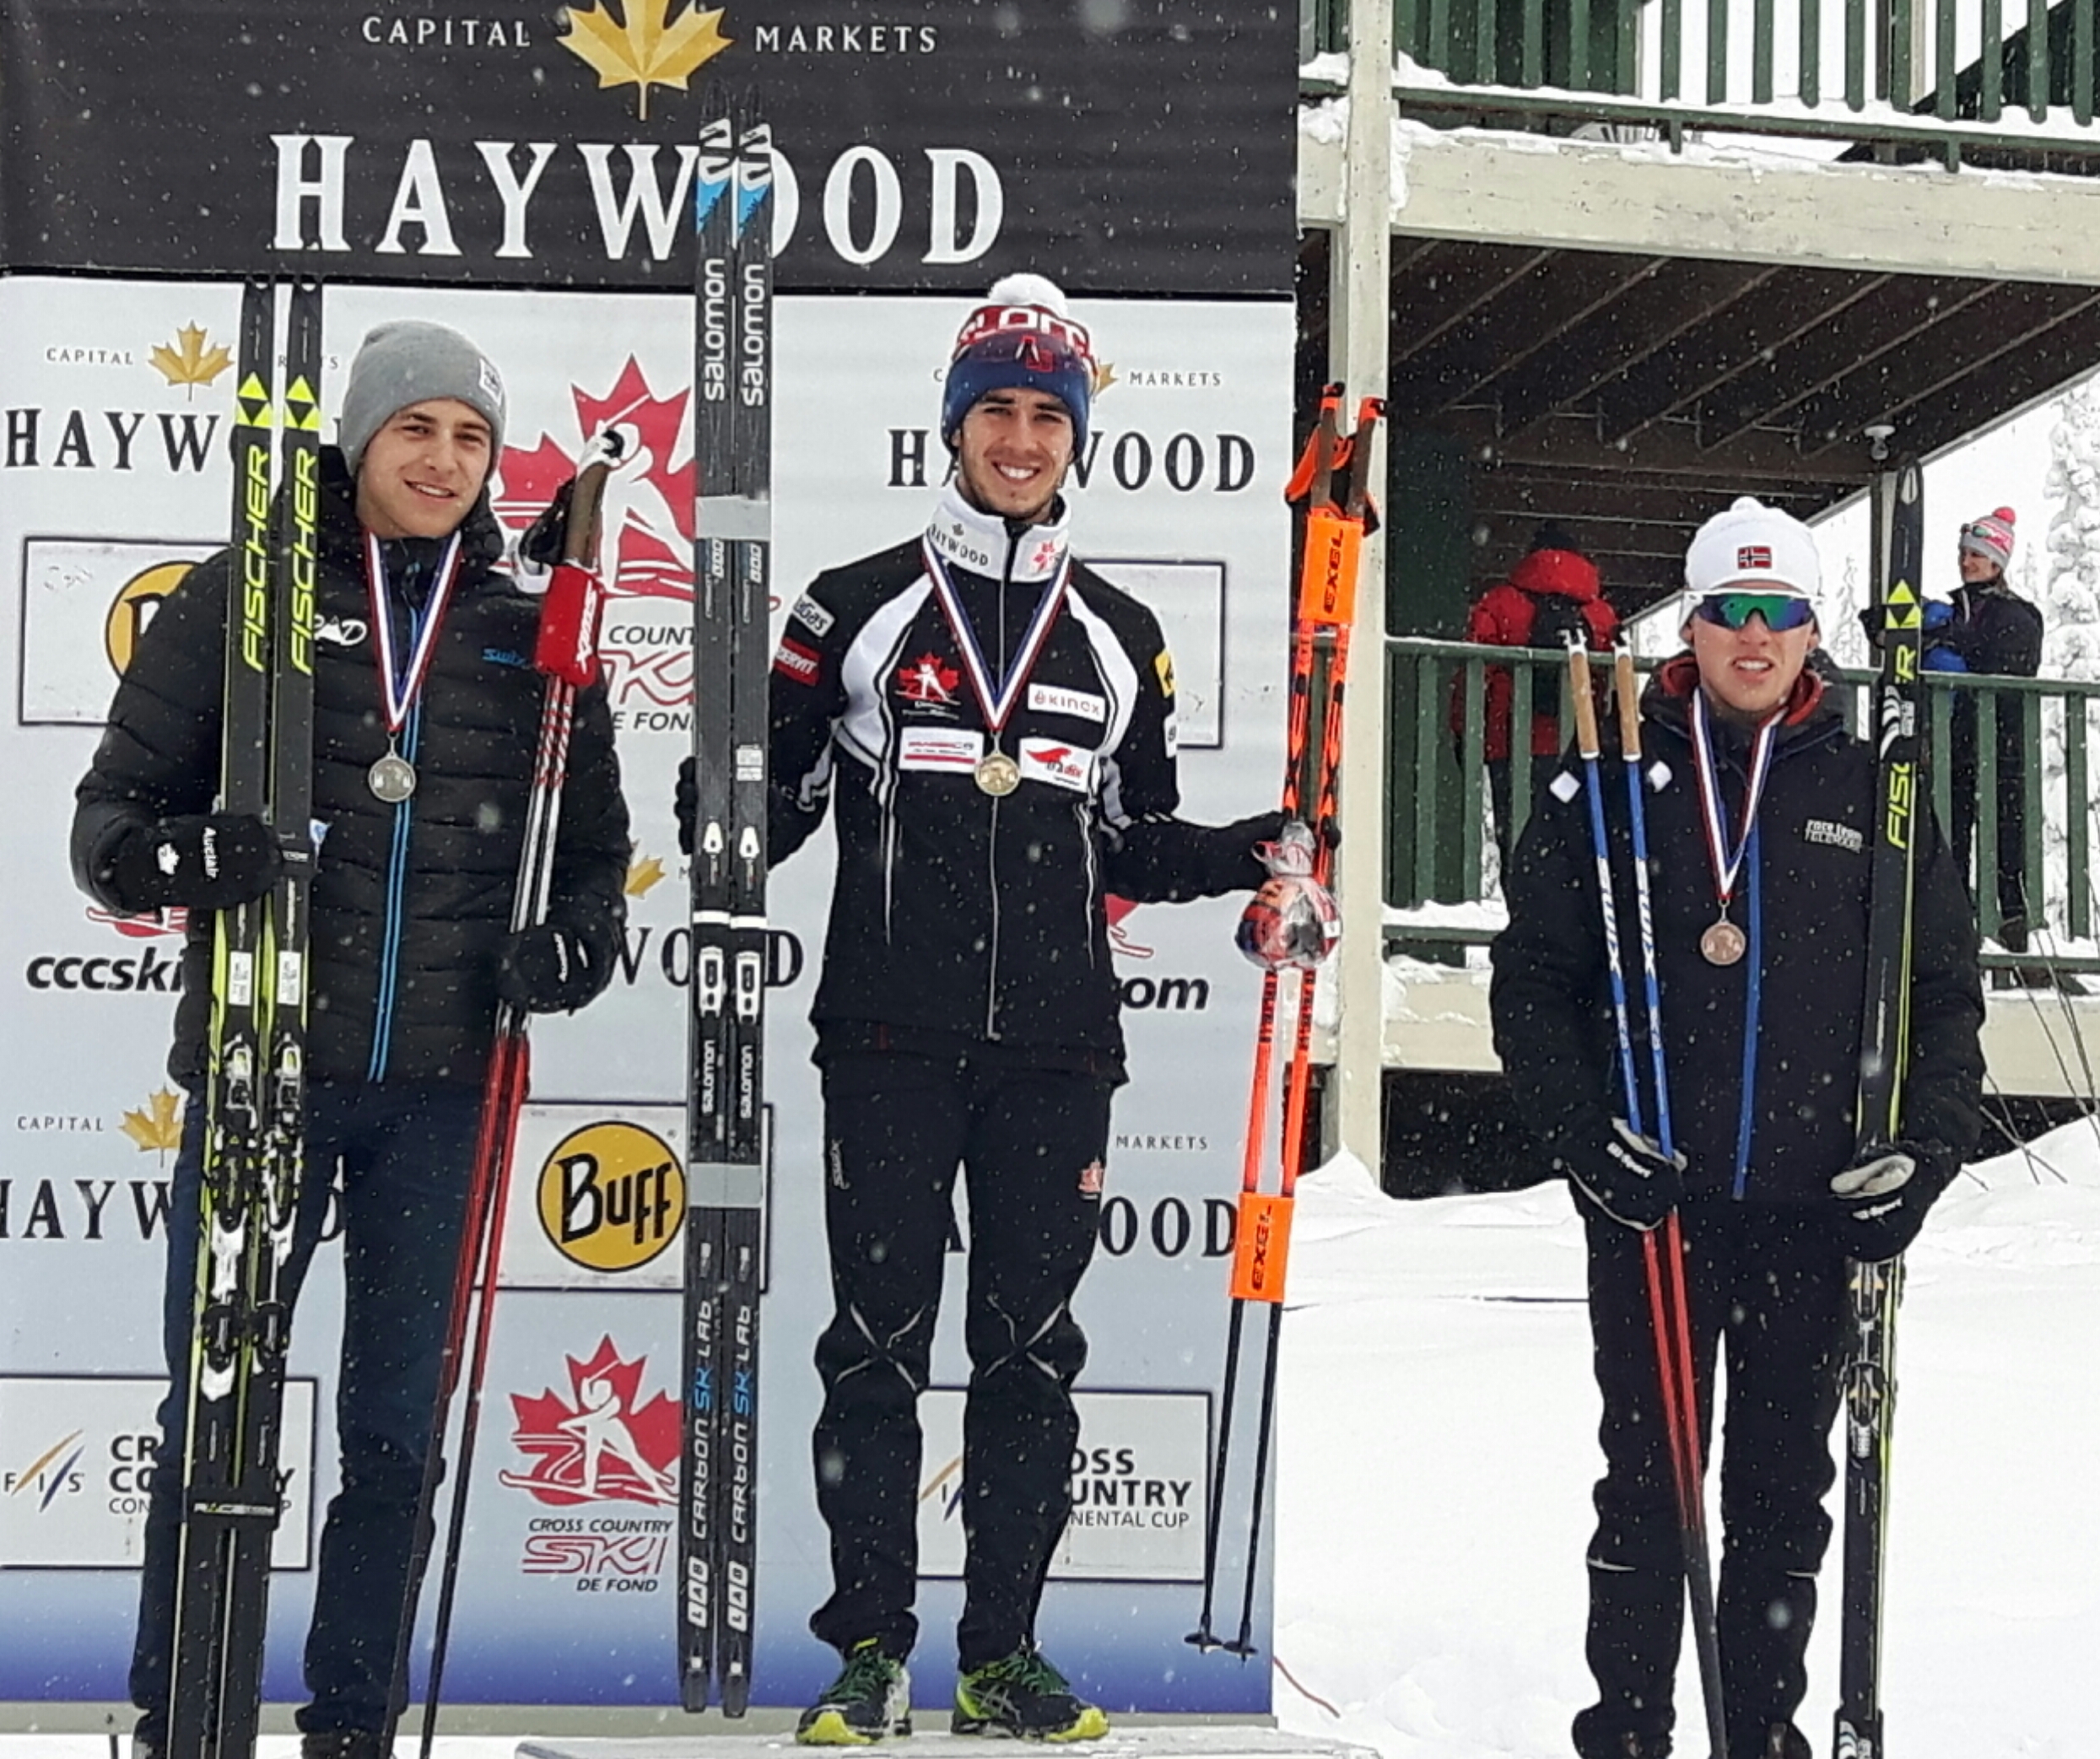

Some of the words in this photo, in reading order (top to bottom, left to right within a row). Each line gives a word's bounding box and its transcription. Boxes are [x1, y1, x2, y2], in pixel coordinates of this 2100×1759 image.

[363, 17, 531, 46] CAPITAL
[755, 26, 937, 52] MARKETS
[46, 348, 133, 365] CAPITAL
[1130, 371, 1222, 386] MARKETS
[5, 409, 240, 473] HAYW
[244, 445, 268, 673] FISCHER
[292, 447, 316, 675] FISCHER
[1323, 528, 1344, 614] EXEL
[634, 713, 694, 731] FON
[18, 1116, 104, 1131] CAPITAL
[1116, 1136, 1209, 1151] MARKETS
[529, 1519, 584, 1533] CROSS
[588, 1519, 673, 1533] COUNTRY
[1151, 1513, 1190, 1528] CUP
[521, 1535, 669, 1575] SKI
[576, 1578, 602, 1592] DE
[605, 1578, 659, 1593] FOND
